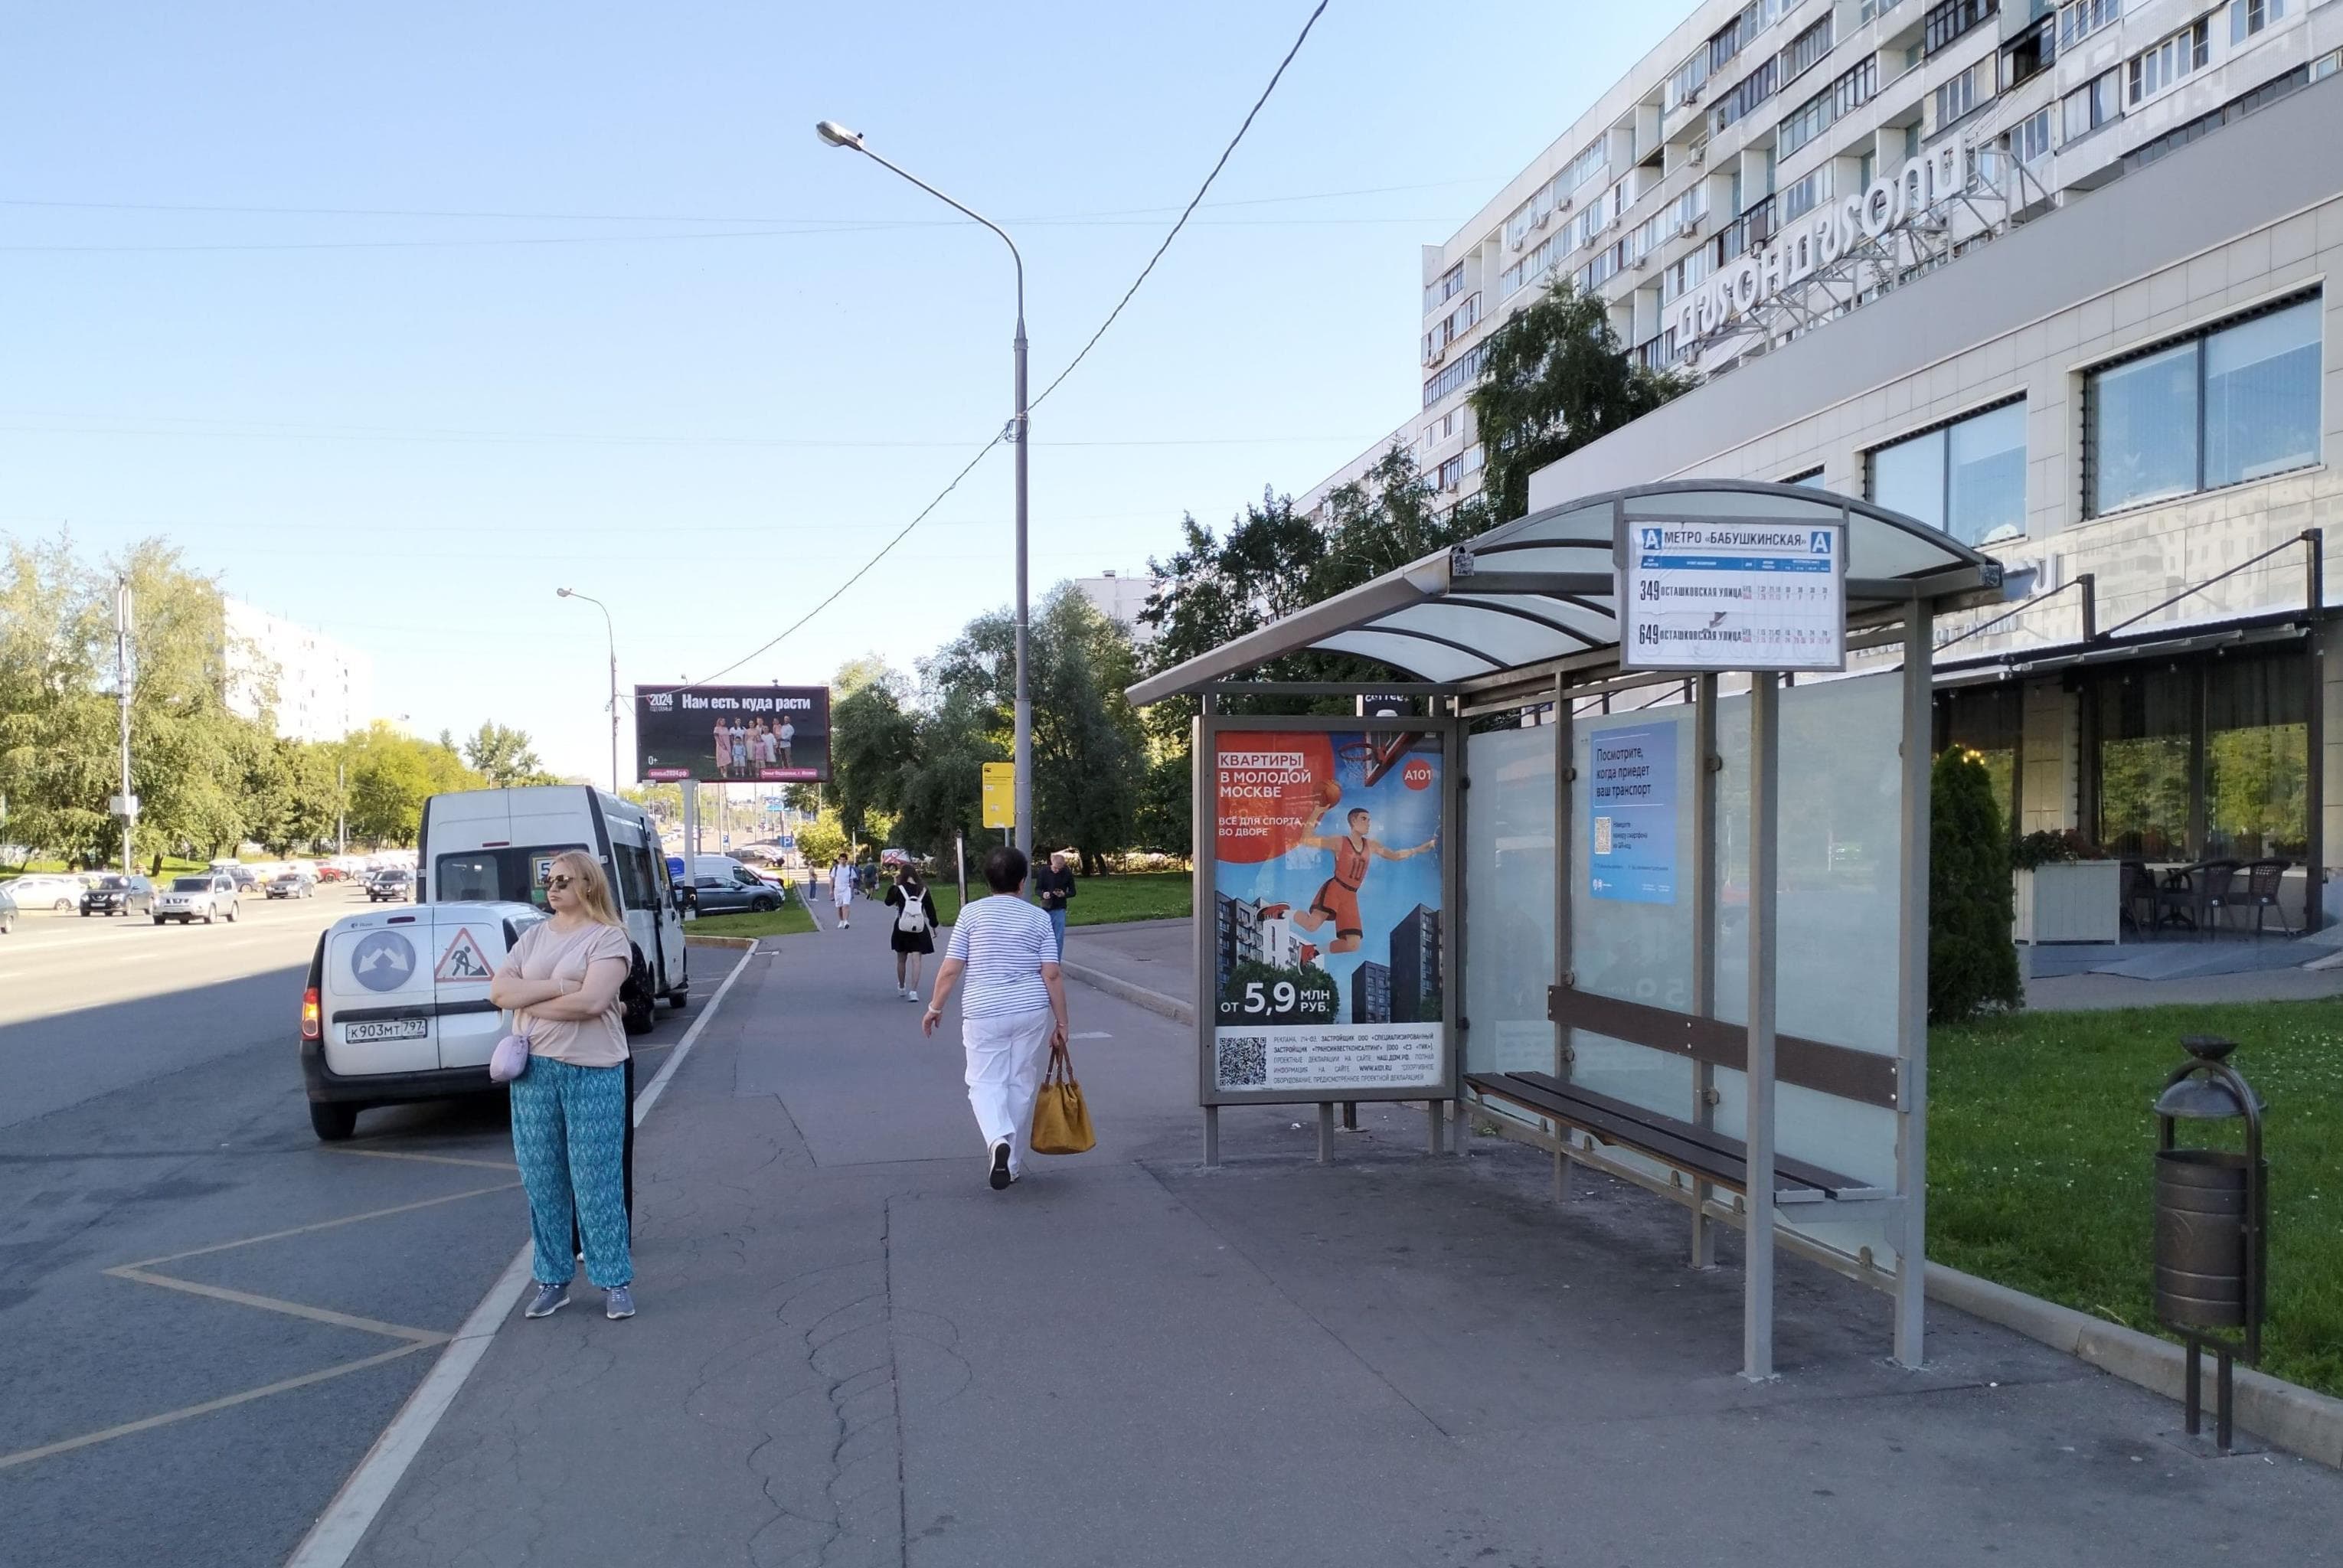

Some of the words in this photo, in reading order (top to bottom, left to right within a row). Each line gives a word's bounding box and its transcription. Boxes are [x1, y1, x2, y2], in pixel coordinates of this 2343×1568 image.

[1664, 531, 1702, 544] МЕТРО
[1704, 532, 1807, 546] «БАБУШКИНСКАЯ»
[1640, 580, 1660, 601] 349
[1660, 586, 1717, 597] ОСТАШКОВСКАЯ
[1718, 587, 1742, 599] УЛИЦА
[1639, 624, 1658, 644] 649
[1659, 629, 1717, 641] ОСТАШКОВСКАЯ
[1718, 630, 1742, 642] УЛИЦА
[649, 694, 674, 706] 2024
[681, 694, 709, 709] Нам
[711, 697, 740, 710] есть
[742, 697, 773, 712] куда
[775, 697, 811, 713] расти
[648, 755, 658, 765] 0+
[1220, 755, 1301, 766] КВАРТИРЫ
[1596, 746, 1644, 762] Посмотрите,
[1220, 772, 1230, 783] В
[1234, 768, 1311, 785] МОЛОДОЙ
[1596, 767, 1616, 780] когда
[1618, 765, 1650, 782] приедет
[1220, 786, 1282, 798] МОСКВЕ
[1596, 787, 1611, 798] ваш
[1612, 782, 1652, 799] транспорт
[1240, 817, 1260, 826] ДЛЯ
[1235, 828, 1268, 838] ДВОРЕ
[1221, 1002, 1240, 1013] ОТ
[1244, 981, 1296, 1016] 5,9
[1300, 990, 1331, 1000] МЛН
[1300, 1002, 1330, 1012] РУБ.
